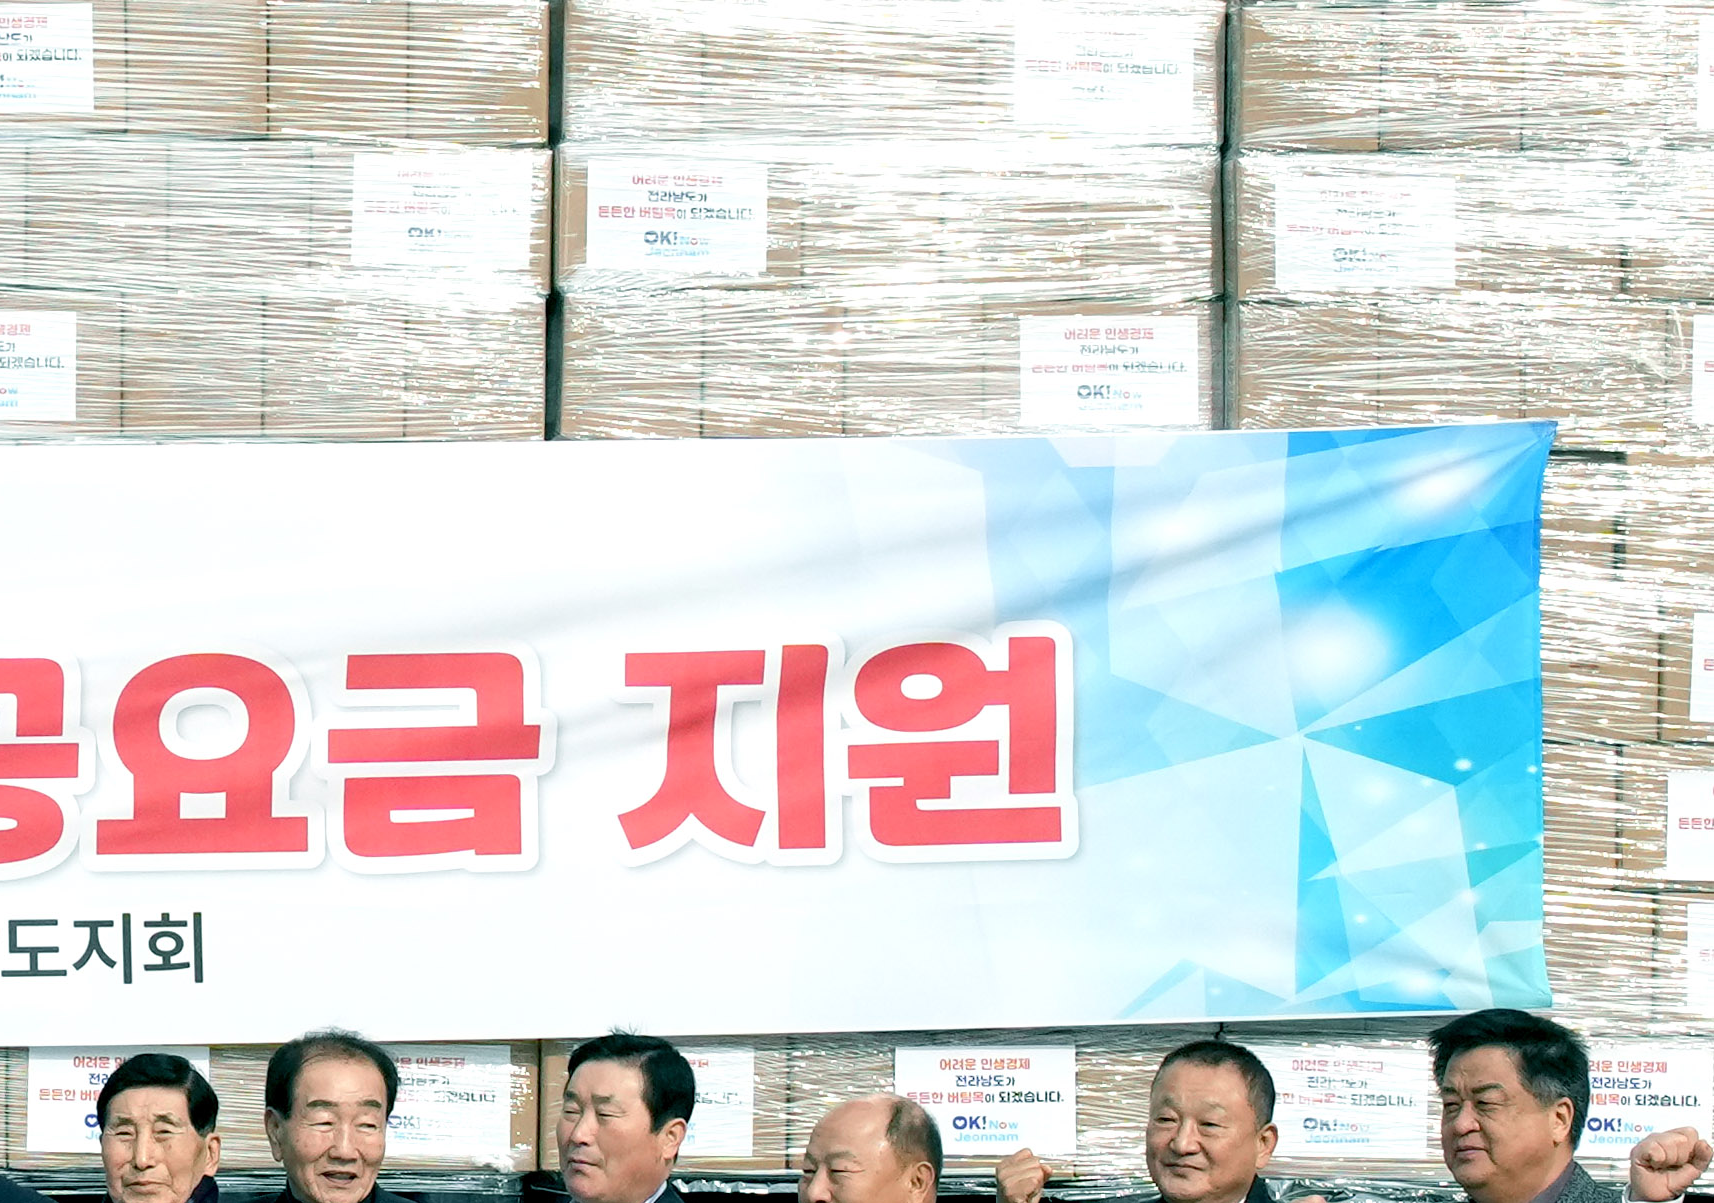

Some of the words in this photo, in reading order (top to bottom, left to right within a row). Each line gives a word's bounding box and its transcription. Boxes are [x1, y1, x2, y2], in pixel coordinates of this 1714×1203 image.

[618, 637, 1061, 849] 지원
[73, 1056, 110, 1069] 어려운
[940, 1059, 976, 1070] 어려운
[982, 1059, 1030, 1070] 민생경제
[1588, 1060, 1613, 1073] 려운
[1618, 1061, 1667, 1074] 민생경제
[956, 1076, 1016, 1087] 전라남도가
[1591, 1077, 1652, 1090] 전라남도가
[40, 1089, 76, 1101] 든든한
[948, 1093, 994, 1103] 버팀목이
[998, 1092, 1064, 1103] 되겠습니다.
[1634, 1094, 1700, 1108] 되겠습니다.
[952, 1116, 986, 1130] OK!
[1588, 1133, 1643, 1145] Jeonna
